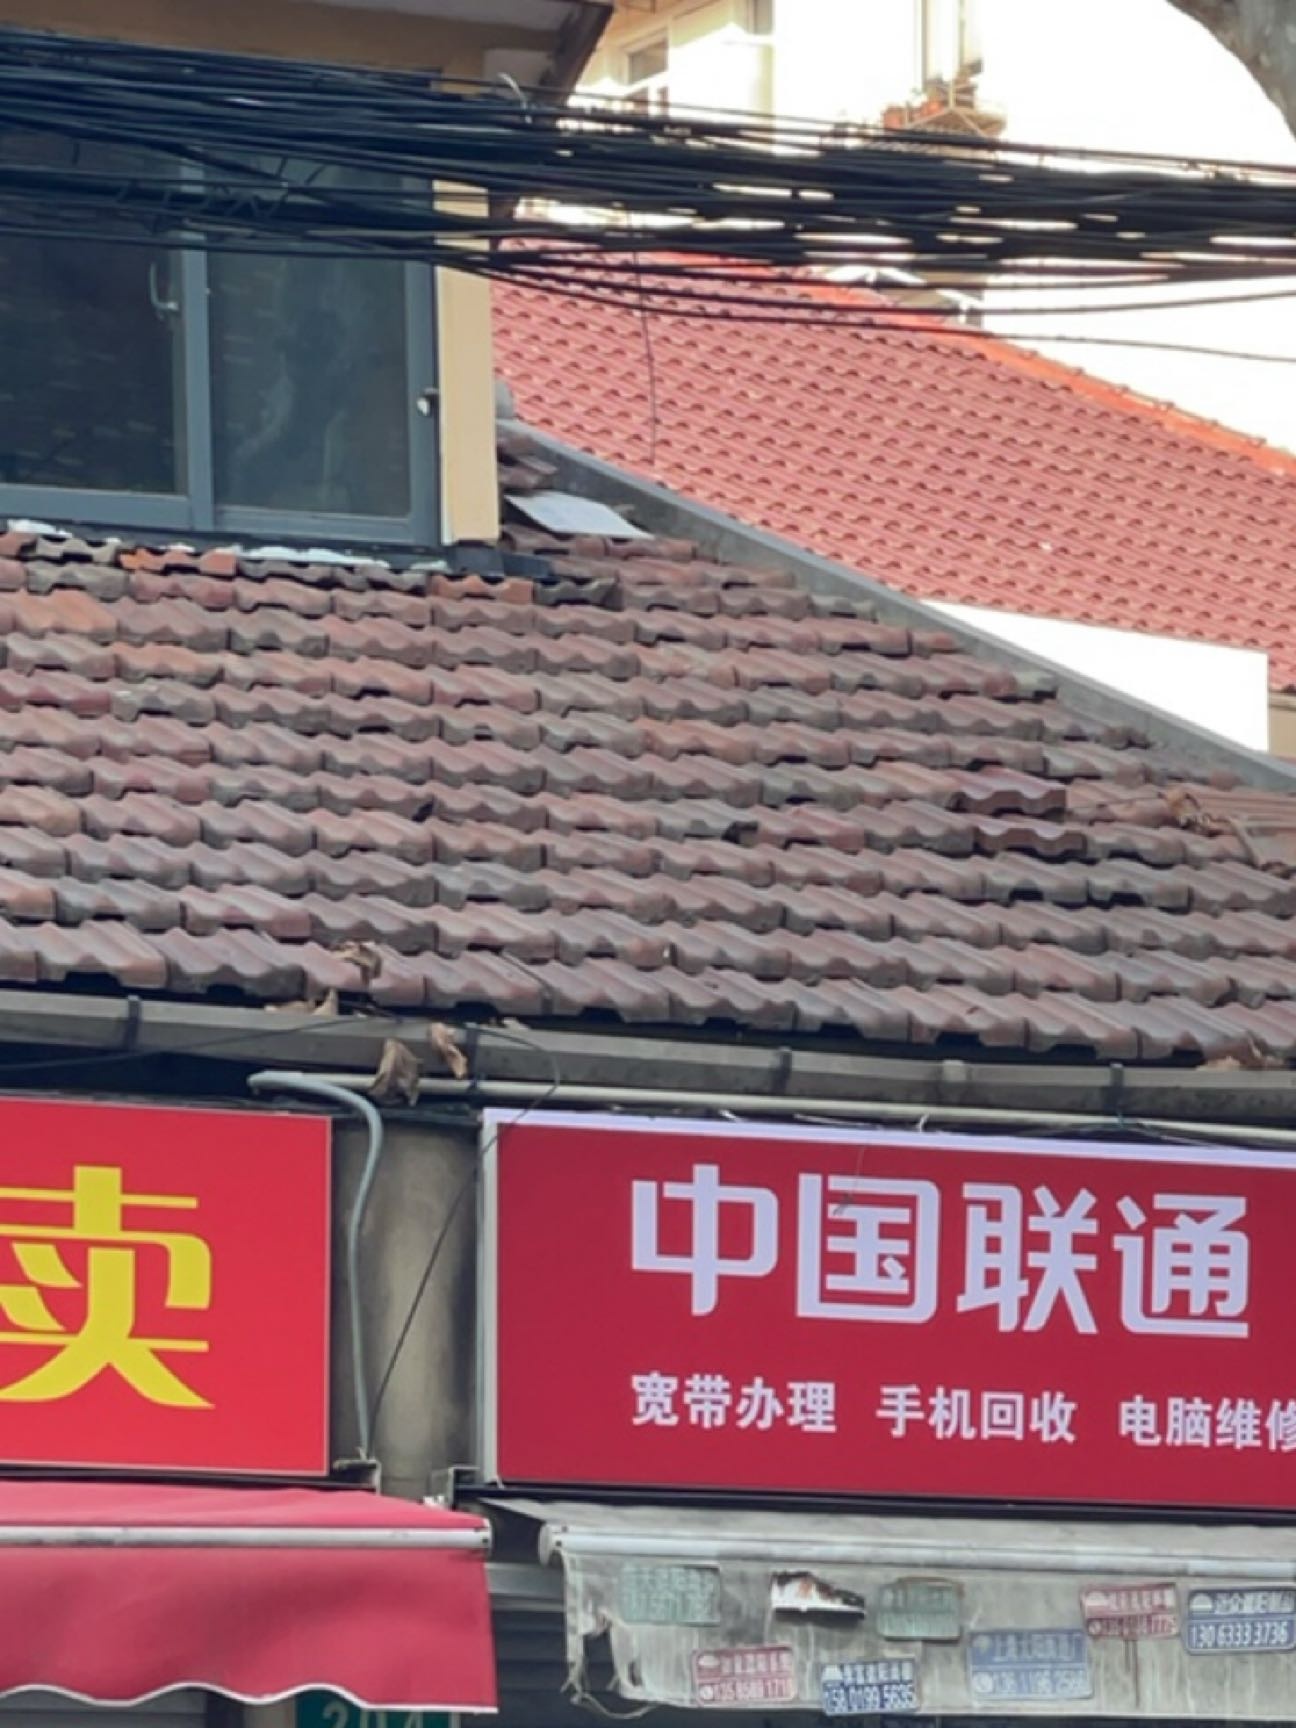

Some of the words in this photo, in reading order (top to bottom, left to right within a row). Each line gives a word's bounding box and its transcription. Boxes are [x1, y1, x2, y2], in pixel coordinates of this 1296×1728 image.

[0, 1164, 214, 1409] 卖
[631, 1163, 1249, 1338] 中国联通
[631, 1372, 836, 1434] 宽带办理
[876, 1384, 1077, 1443] 手机回收
